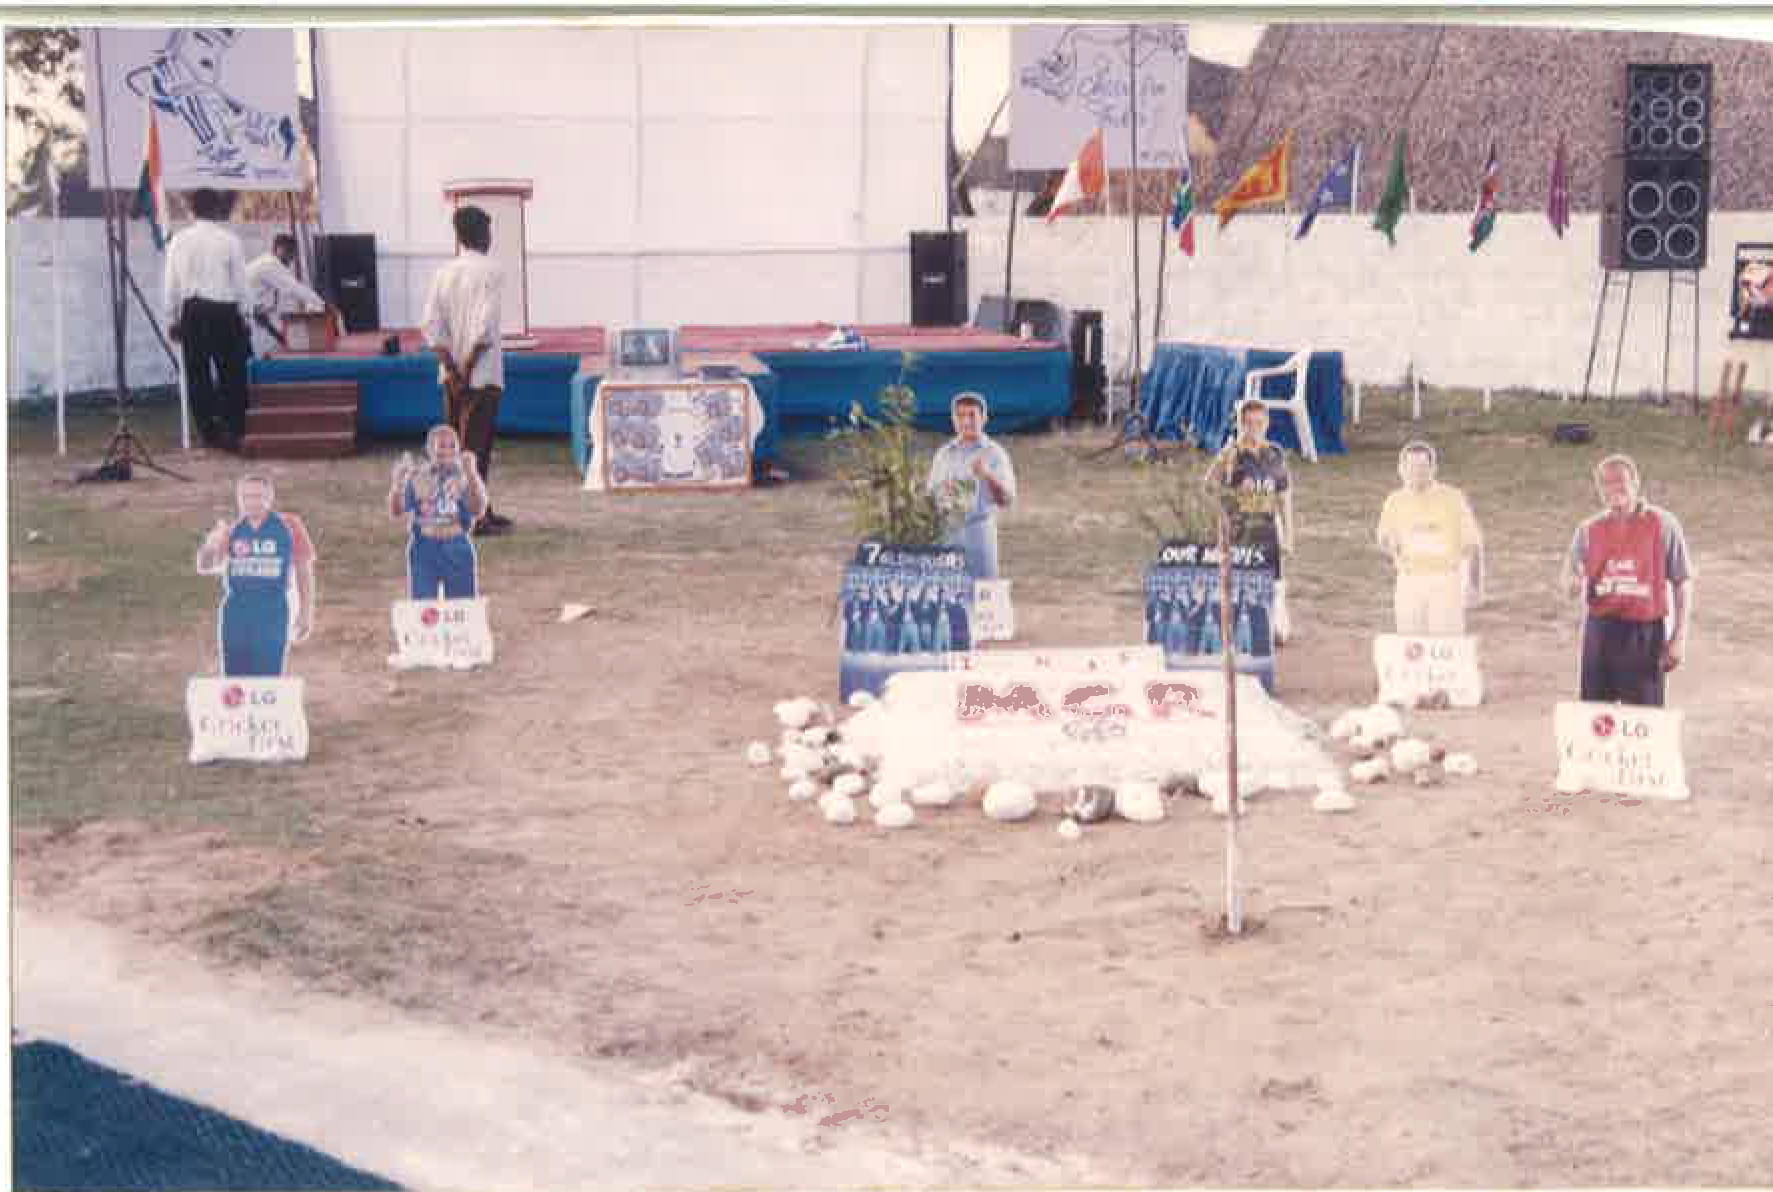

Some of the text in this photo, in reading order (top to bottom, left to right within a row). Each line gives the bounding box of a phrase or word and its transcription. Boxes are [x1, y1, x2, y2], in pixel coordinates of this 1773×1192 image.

[252, 538, 278, 554] LG
[249, 688, 278, 706] LG
[1622, 718, 1650, 738] LG
